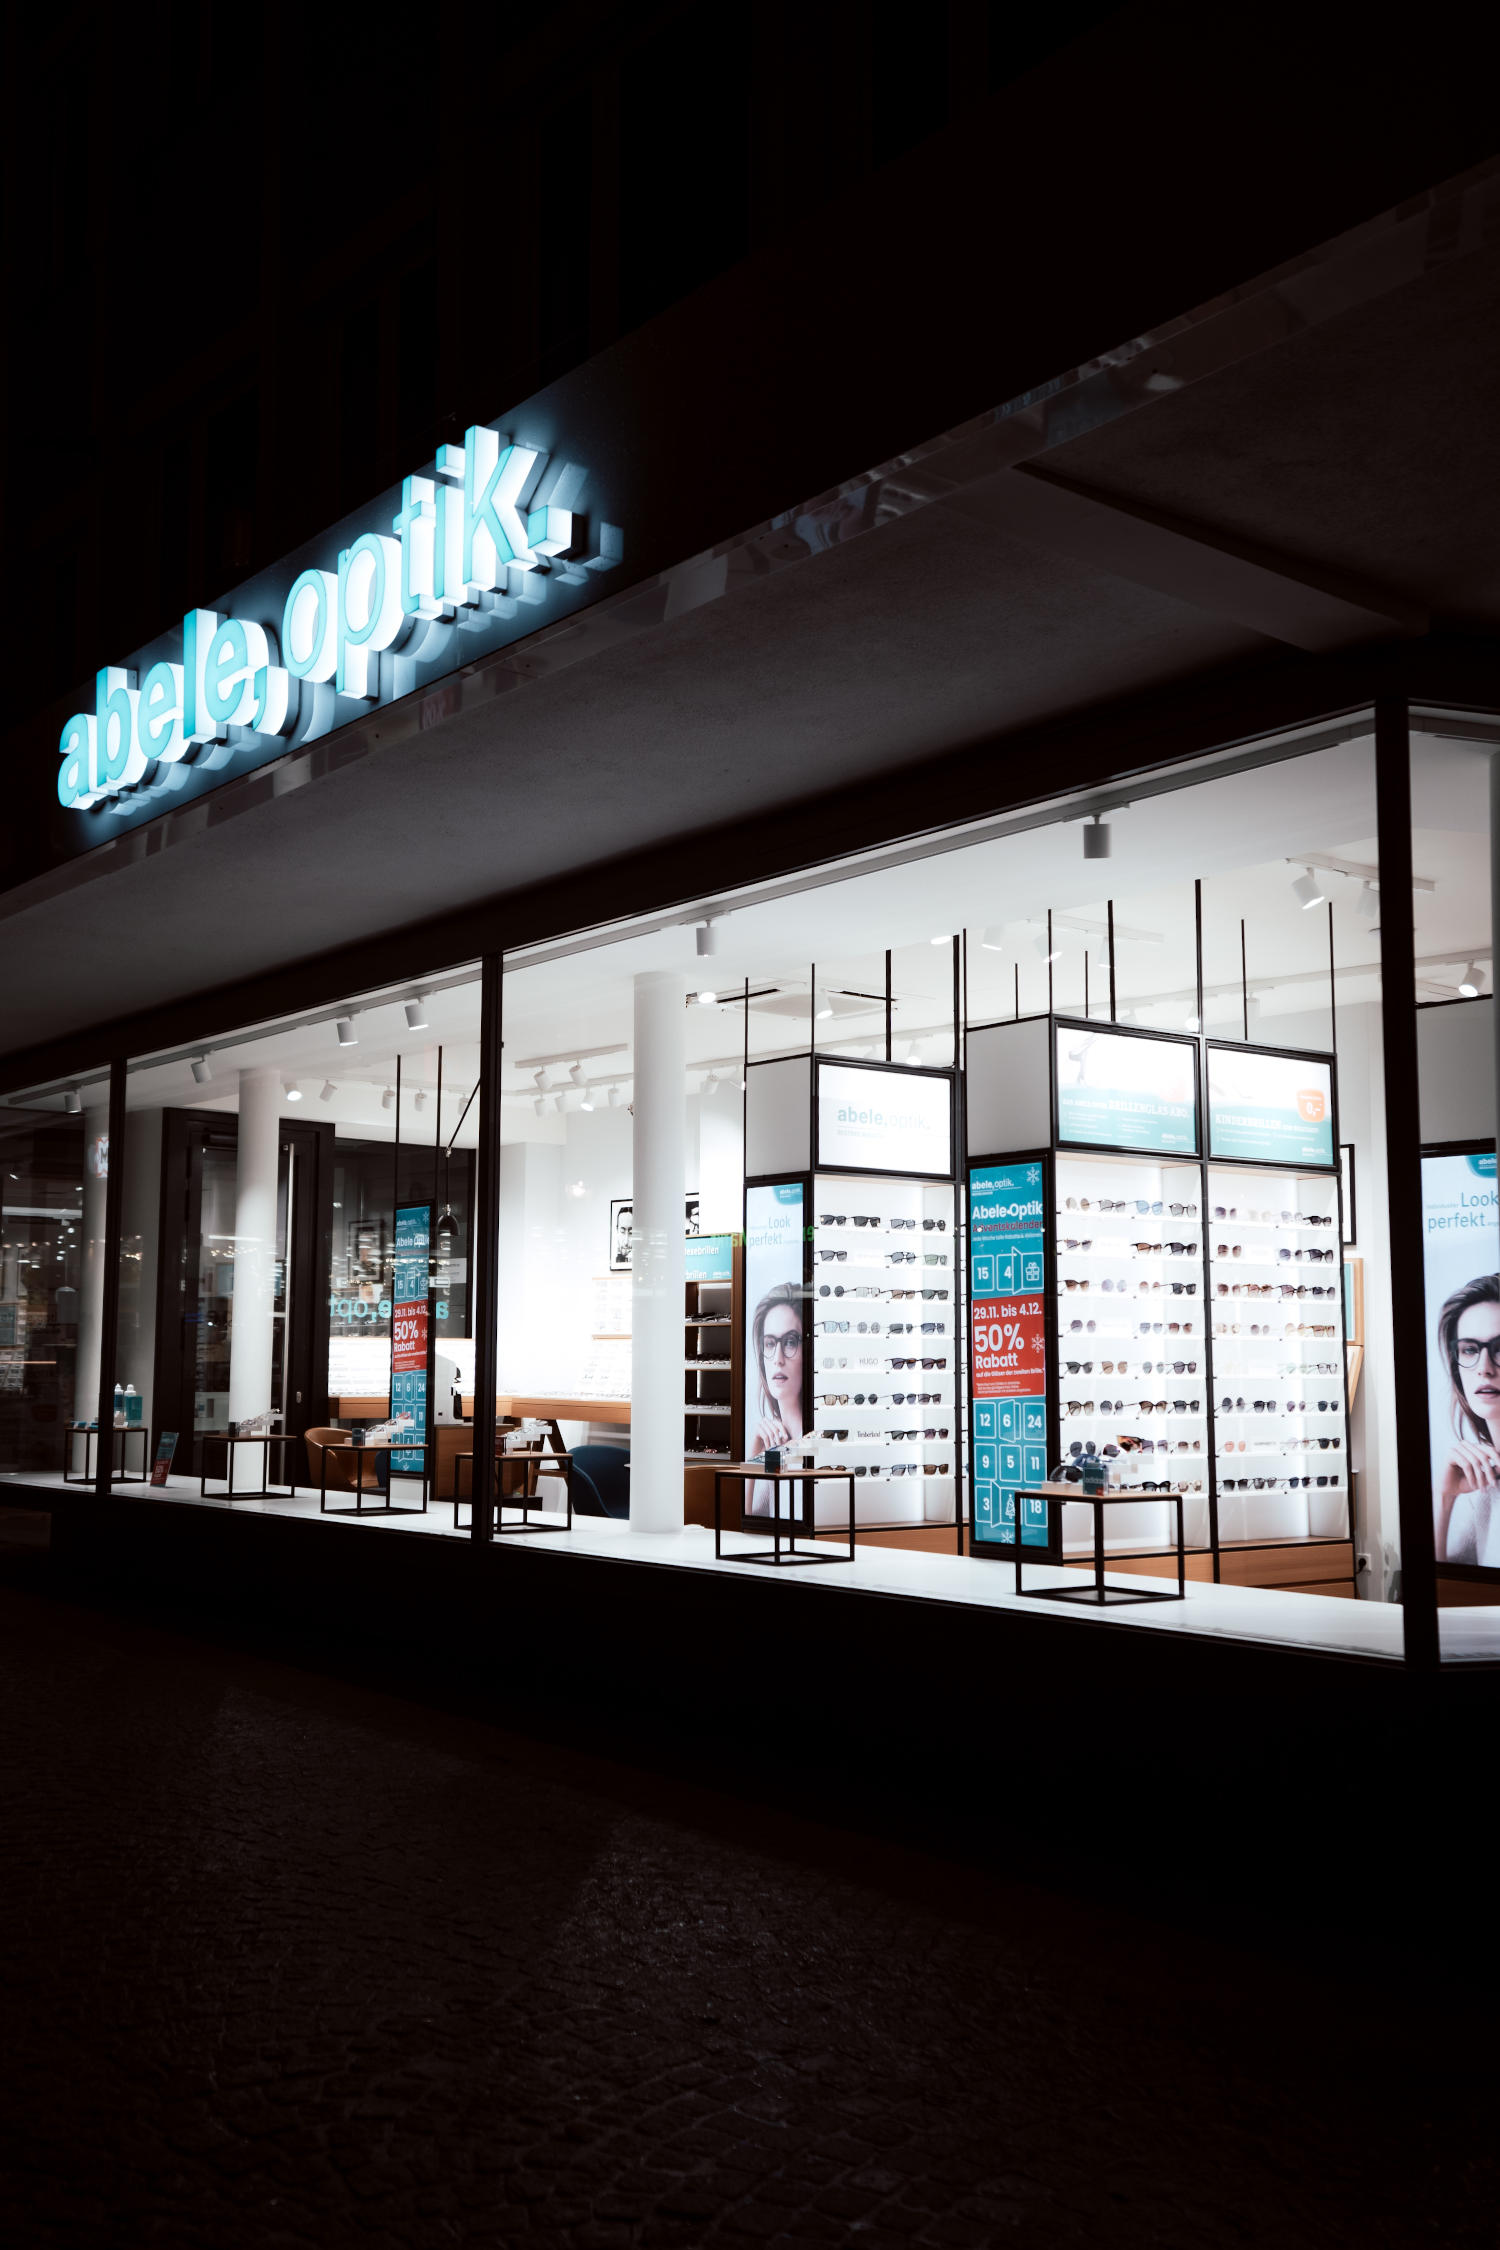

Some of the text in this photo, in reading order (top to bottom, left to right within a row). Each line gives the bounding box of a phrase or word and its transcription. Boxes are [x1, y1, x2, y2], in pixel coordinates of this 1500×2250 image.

[1461, 1190, 1498, 1208] Look
[768, 1216, 791, 1229] Look
[1428, 1212, 1485, 1233] perfekt
[749, 1232, 783, 1249] perfekt
[977, 1267, 989, 1280] 15
[1004, 1266, 1012, 1279] 4
[974, 1302, 1042, 1320] 29.11. bis 4.12.
[394, 1320, 419, 1341] 50%
[975, 1323, 1025, 1353] 50%
[394, 1341, 415, 1352] Rabatt
[975, 1352, 1019, 1369] Rabatt
[980, 1413, 991, 1427] 12
[1003, 1413, 1011, 1427] 6
[1027, 1414, 1042, 1428] 24
[982, 1455, 990, 1469] 9
[1007, 1455, 1014, 1469] 5
[1030, 1456, 1040, 1470] 11
[983, 1498, 990, 1511] 3
[1030, 1499, 1042, 1514] 18
